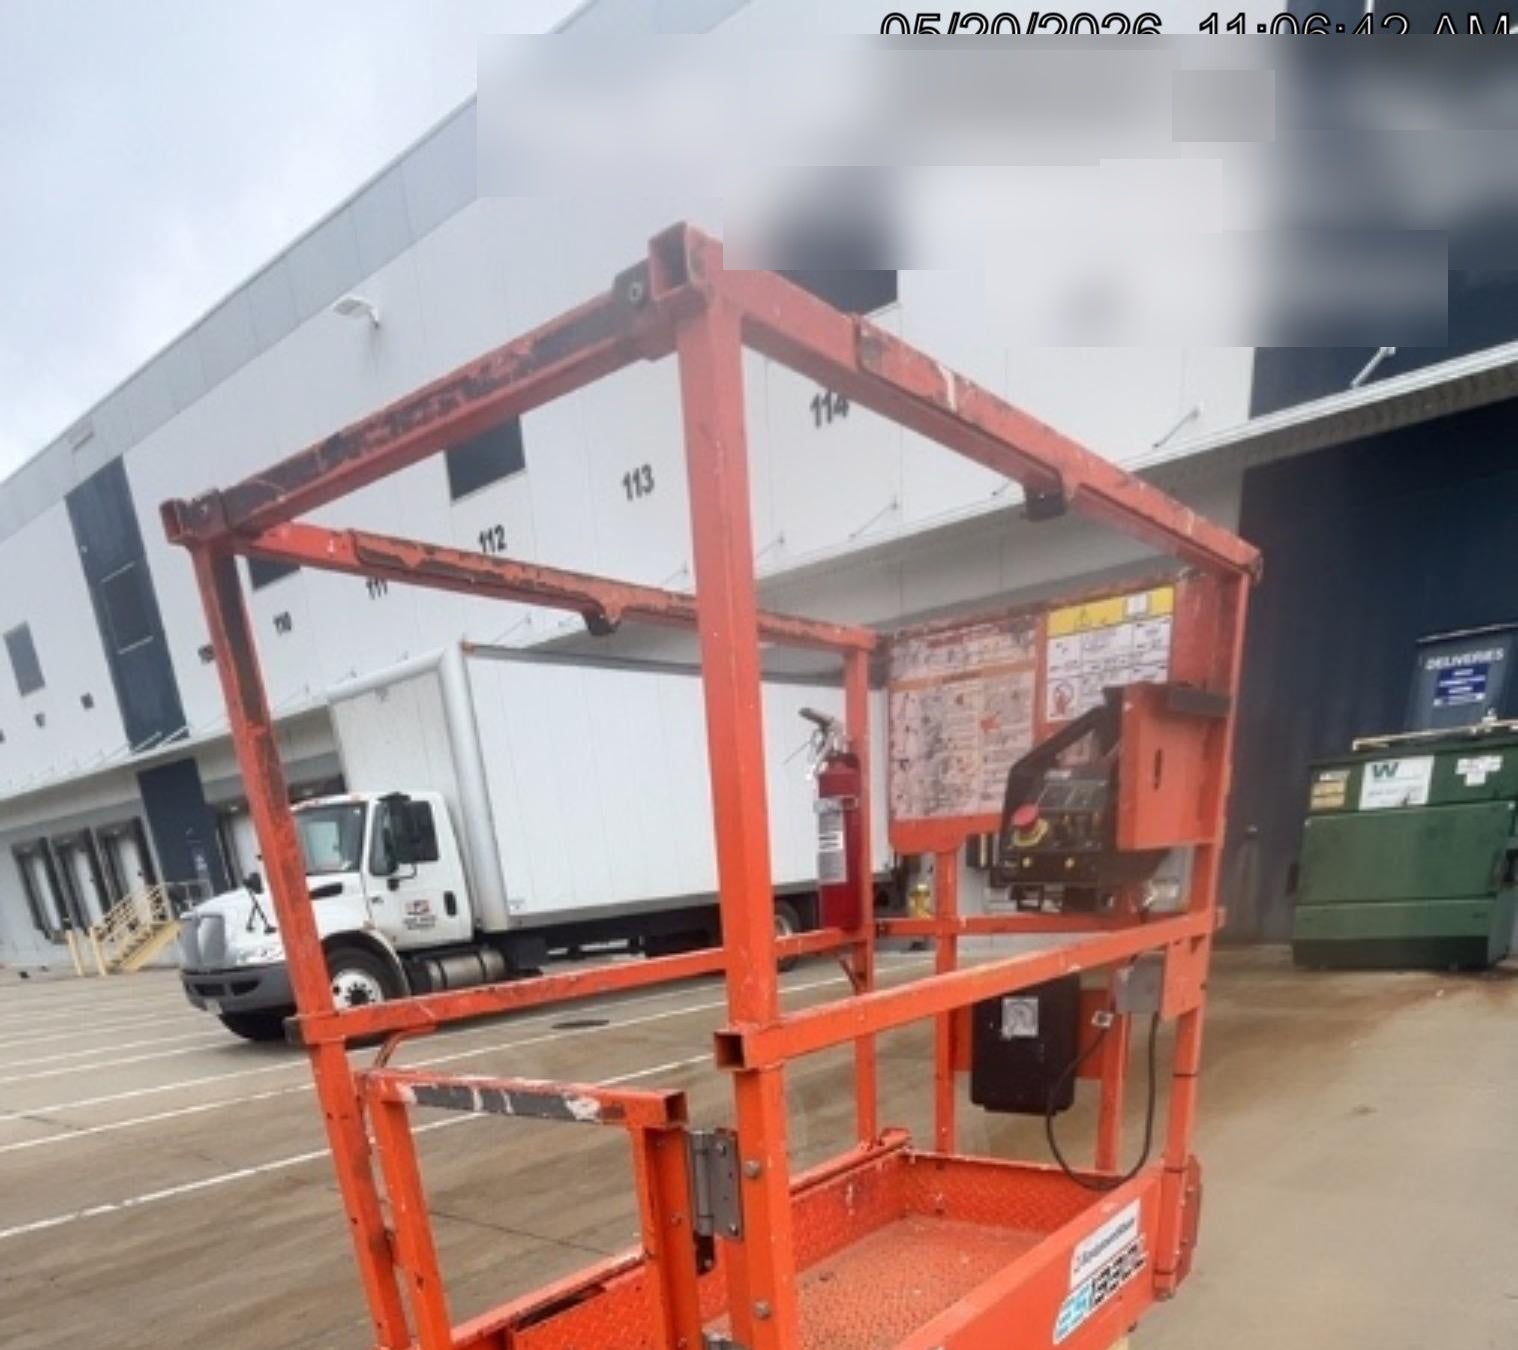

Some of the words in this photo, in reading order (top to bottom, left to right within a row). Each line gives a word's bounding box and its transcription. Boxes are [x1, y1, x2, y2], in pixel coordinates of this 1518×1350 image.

[810, 390, 850, 428] 114
[622, 463, 655, 501] 113
[478, 524, 507, 553] 112
[1425, 648, 1504, 670] DELIVERIES
